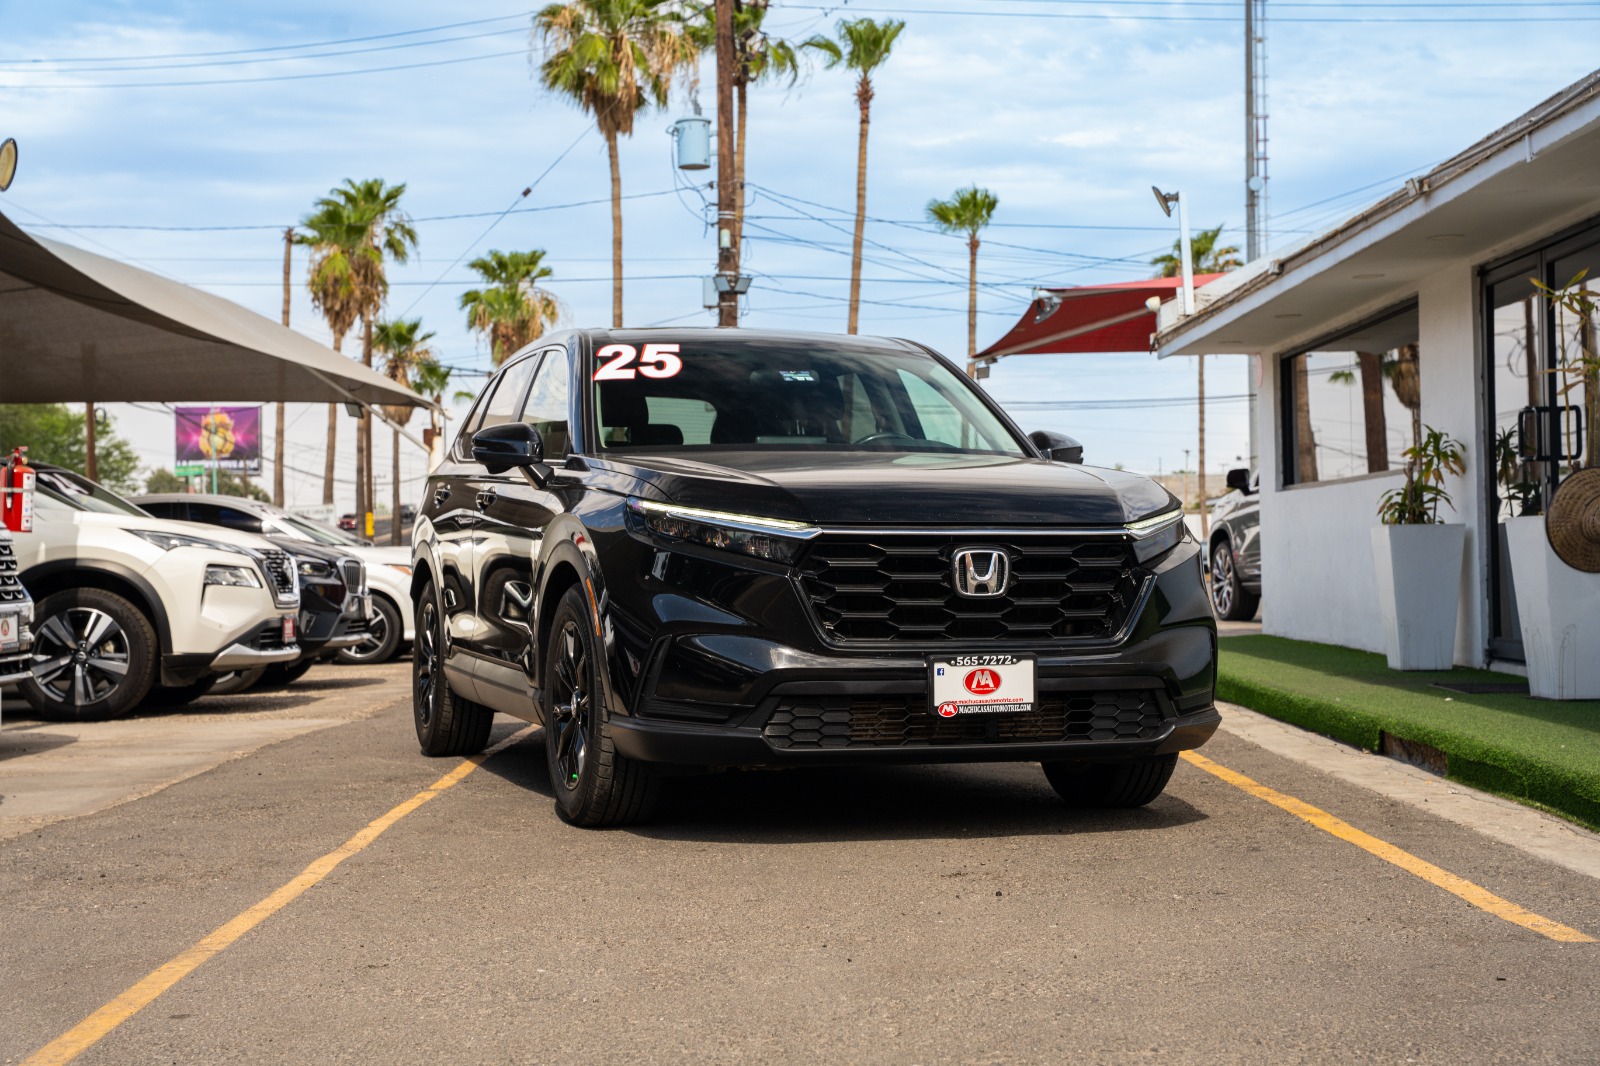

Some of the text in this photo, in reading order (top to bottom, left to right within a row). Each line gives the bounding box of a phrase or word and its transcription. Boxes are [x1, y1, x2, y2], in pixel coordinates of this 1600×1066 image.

[592, 343, 683, 381] 25
[956, 655, 1012, 666] 565-7272
[959, 704, 1032, 713] MACHUCASAUTOMOTRIZ.COM
